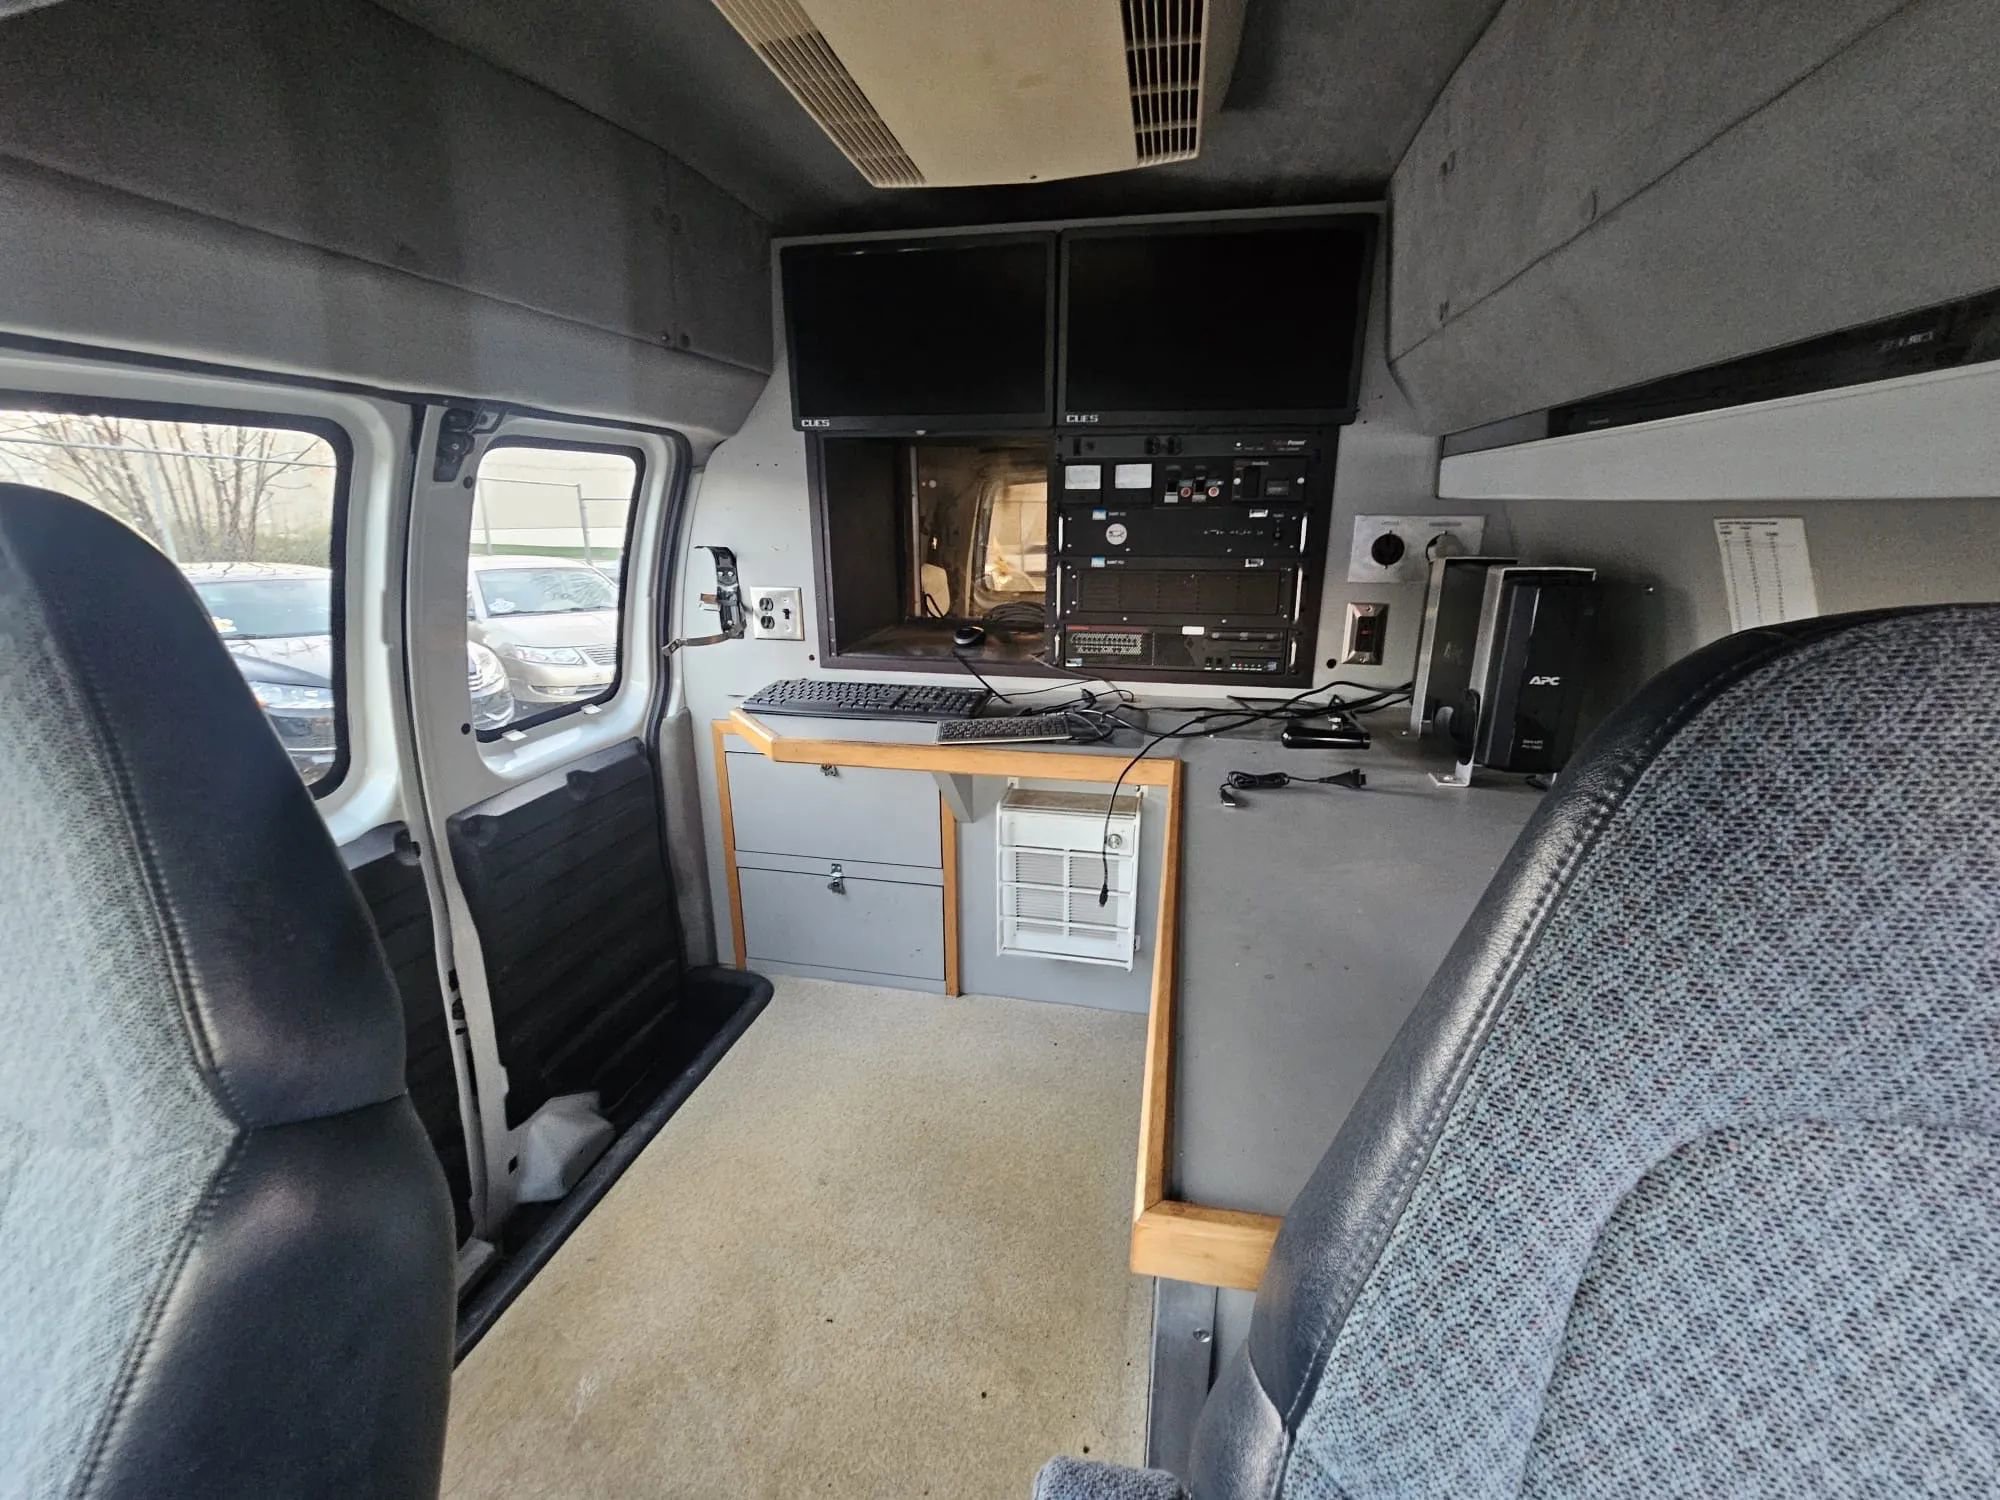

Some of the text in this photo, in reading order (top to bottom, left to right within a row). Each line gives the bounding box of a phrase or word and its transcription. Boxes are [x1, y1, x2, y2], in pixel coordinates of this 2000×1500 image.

[801, 419, 830, 427] CUES
[1066, 414, 1099, 423] CUES
[1529, 675, 1561, 686] APC
